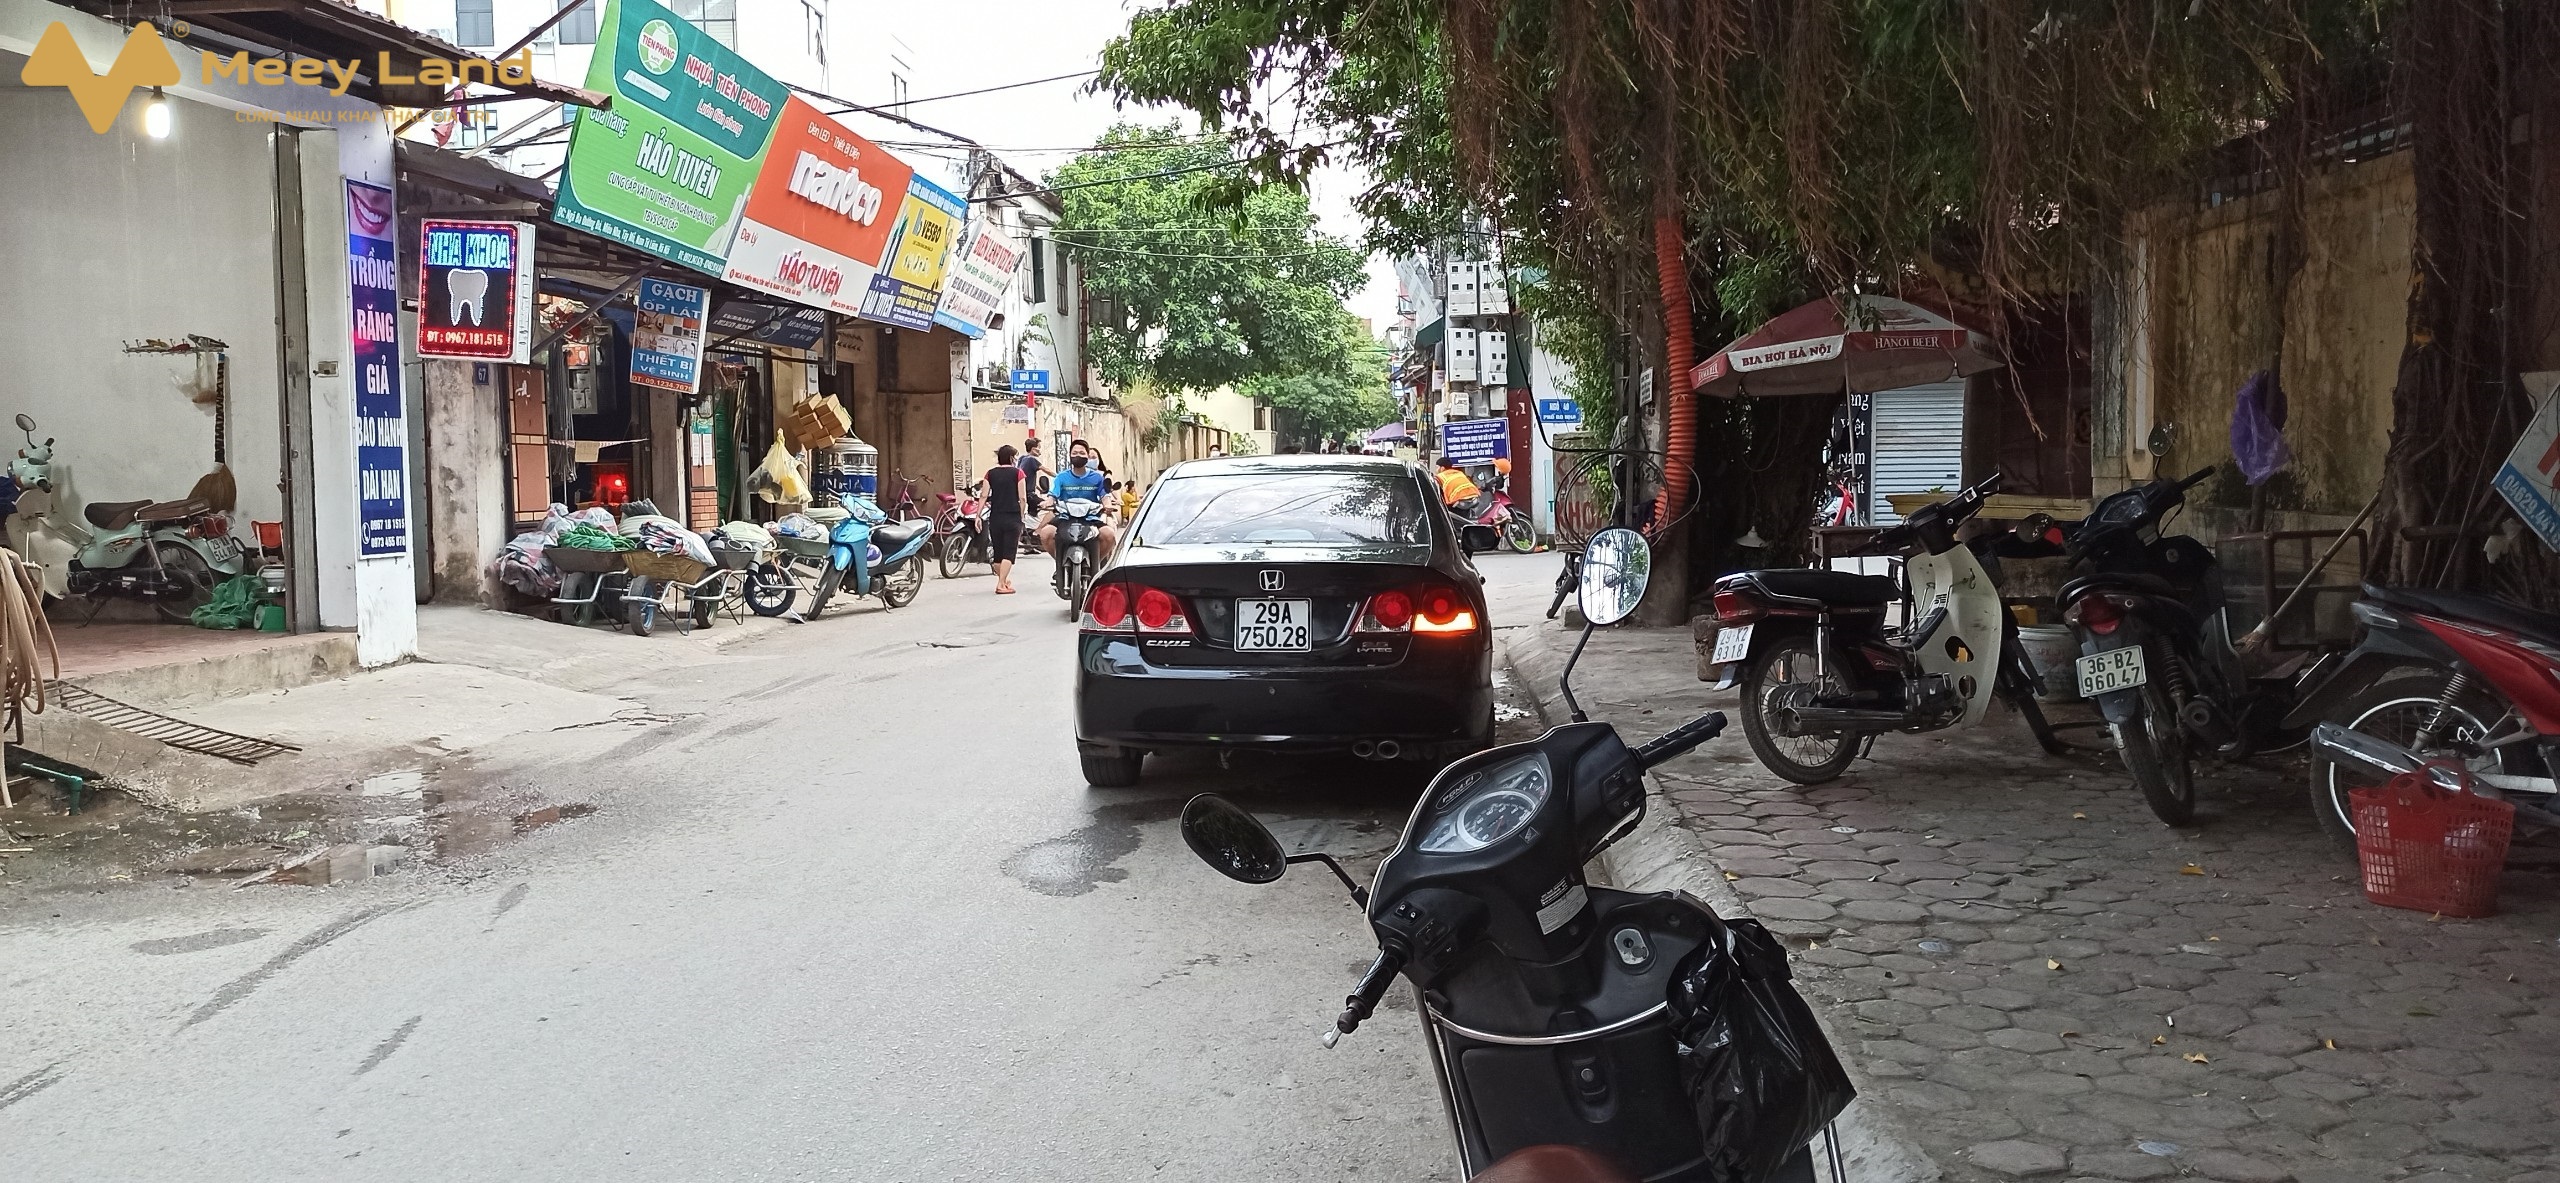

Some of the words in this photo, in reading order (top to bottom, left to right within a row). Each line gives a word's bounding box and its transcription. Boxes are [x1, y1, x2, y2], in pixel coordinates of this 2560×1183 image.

[684, 54, 714, 88] NHỰA
[739, 88, 771, 120] PHONG
[635, 127, 674, 178] HẢO
[428, 232, 462, 266] NHA
[465, 234, 511, 269] KHOA
[350, 247, 395, 290] TRỒNG
[651, 283, 698, 303] GẠCH
[643, 299, 666, 311] ỐP
[671, 305, 701, 318] LÁT
[357, 304, 394, 343] RĂNG
[1742, 356, 1763, 367] BIA
[1765, 351, 1787, 363] HƠI
[1788, 346, 1807, 360] HÀ
[1809, 342, 1832, 356] NỘI
[1875, 336, 1910, 349] HANOI
[1912, 335, 1940, 349] BEER
[366, 355, 390, 395] GIẢ
[478, 368, 486, 381] 67
[638, 352, 676, 367] THIẾT
[680, 360, 693, 373] BỊ
[640, 365, 656, 375] VỆ
[660, 369, 689, 380] SINH
[357, 406, 375, 447] BẢO
[378, 411, 402, 447] HÀNH
[363, 464, 379, 500] DÀI
[381, 470, 400, 506] HẠN
[1255, 602, 1292, 625] 29A
[1240, 626, 1307, 648] 750.28
[1716, 644, 1743, 661] 9318
[2087, 650, 2135, 675] 36-B2
[2084, 667, 2140, 693] 960.47
[1443, 775, 1474, 803] PGM-FI
